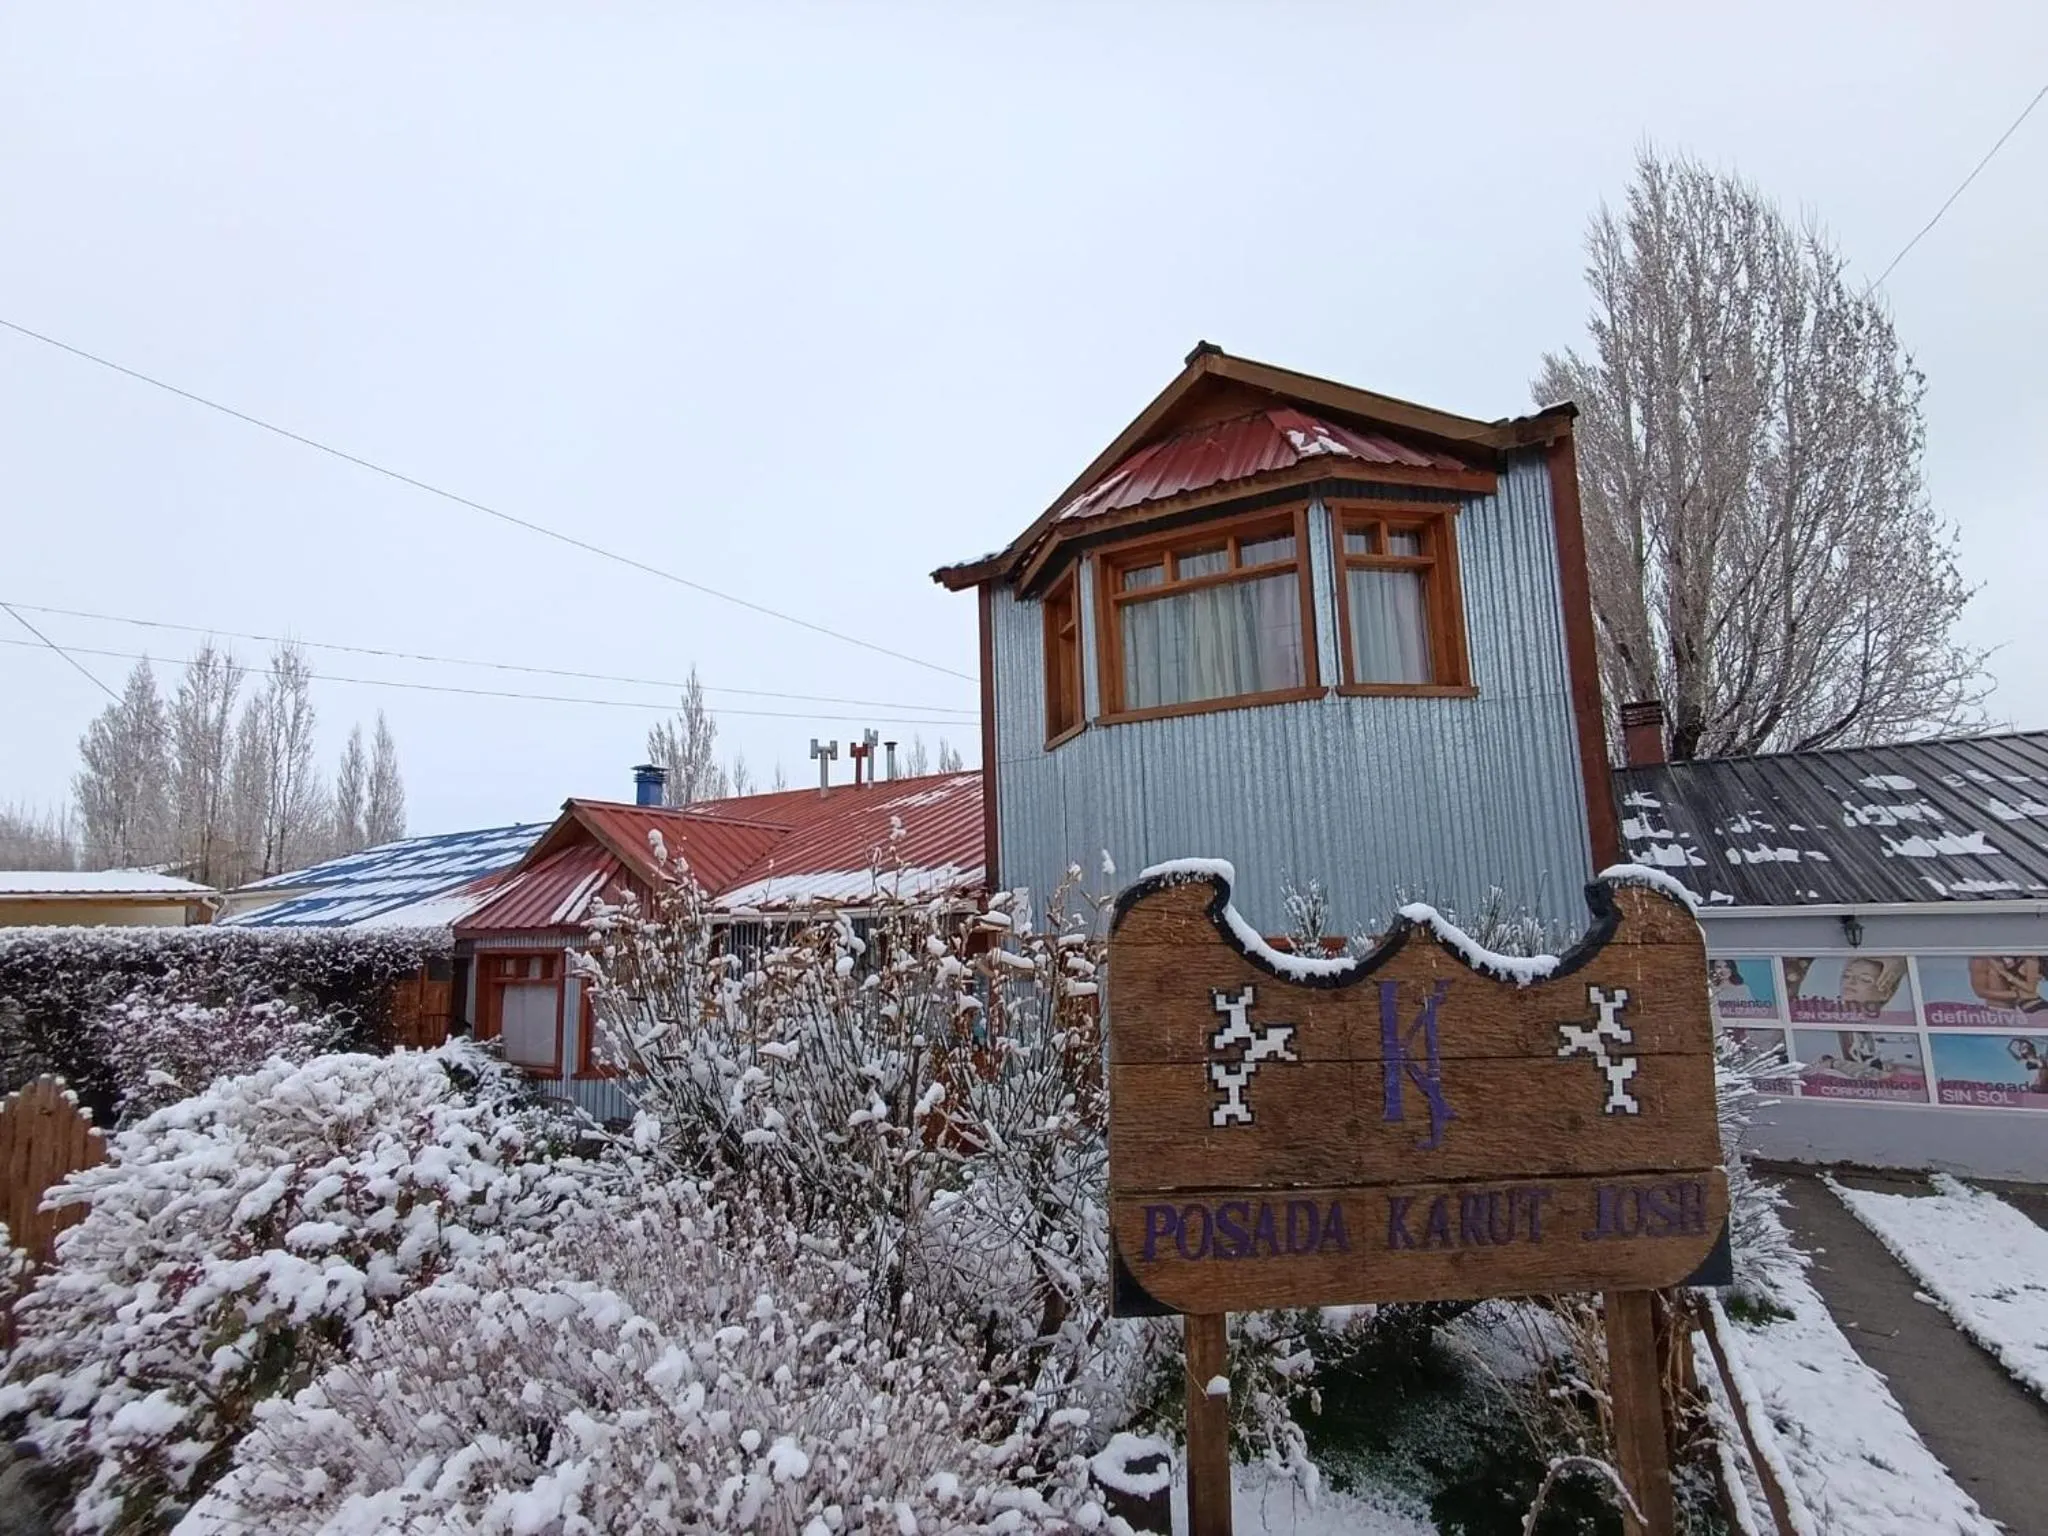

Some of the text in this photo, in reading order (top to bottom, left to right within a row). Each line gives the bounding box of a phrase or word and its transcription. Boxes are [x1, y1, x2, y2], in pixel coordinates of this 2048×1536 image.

[1931, 1009, 2029, 1025] definitiva
[1942, 1089, 2016, 1105] SIN SOL
[1141, 1200, 1350, 1262] POSADA
[1581, 1178, 1709, 1241] JOSH
